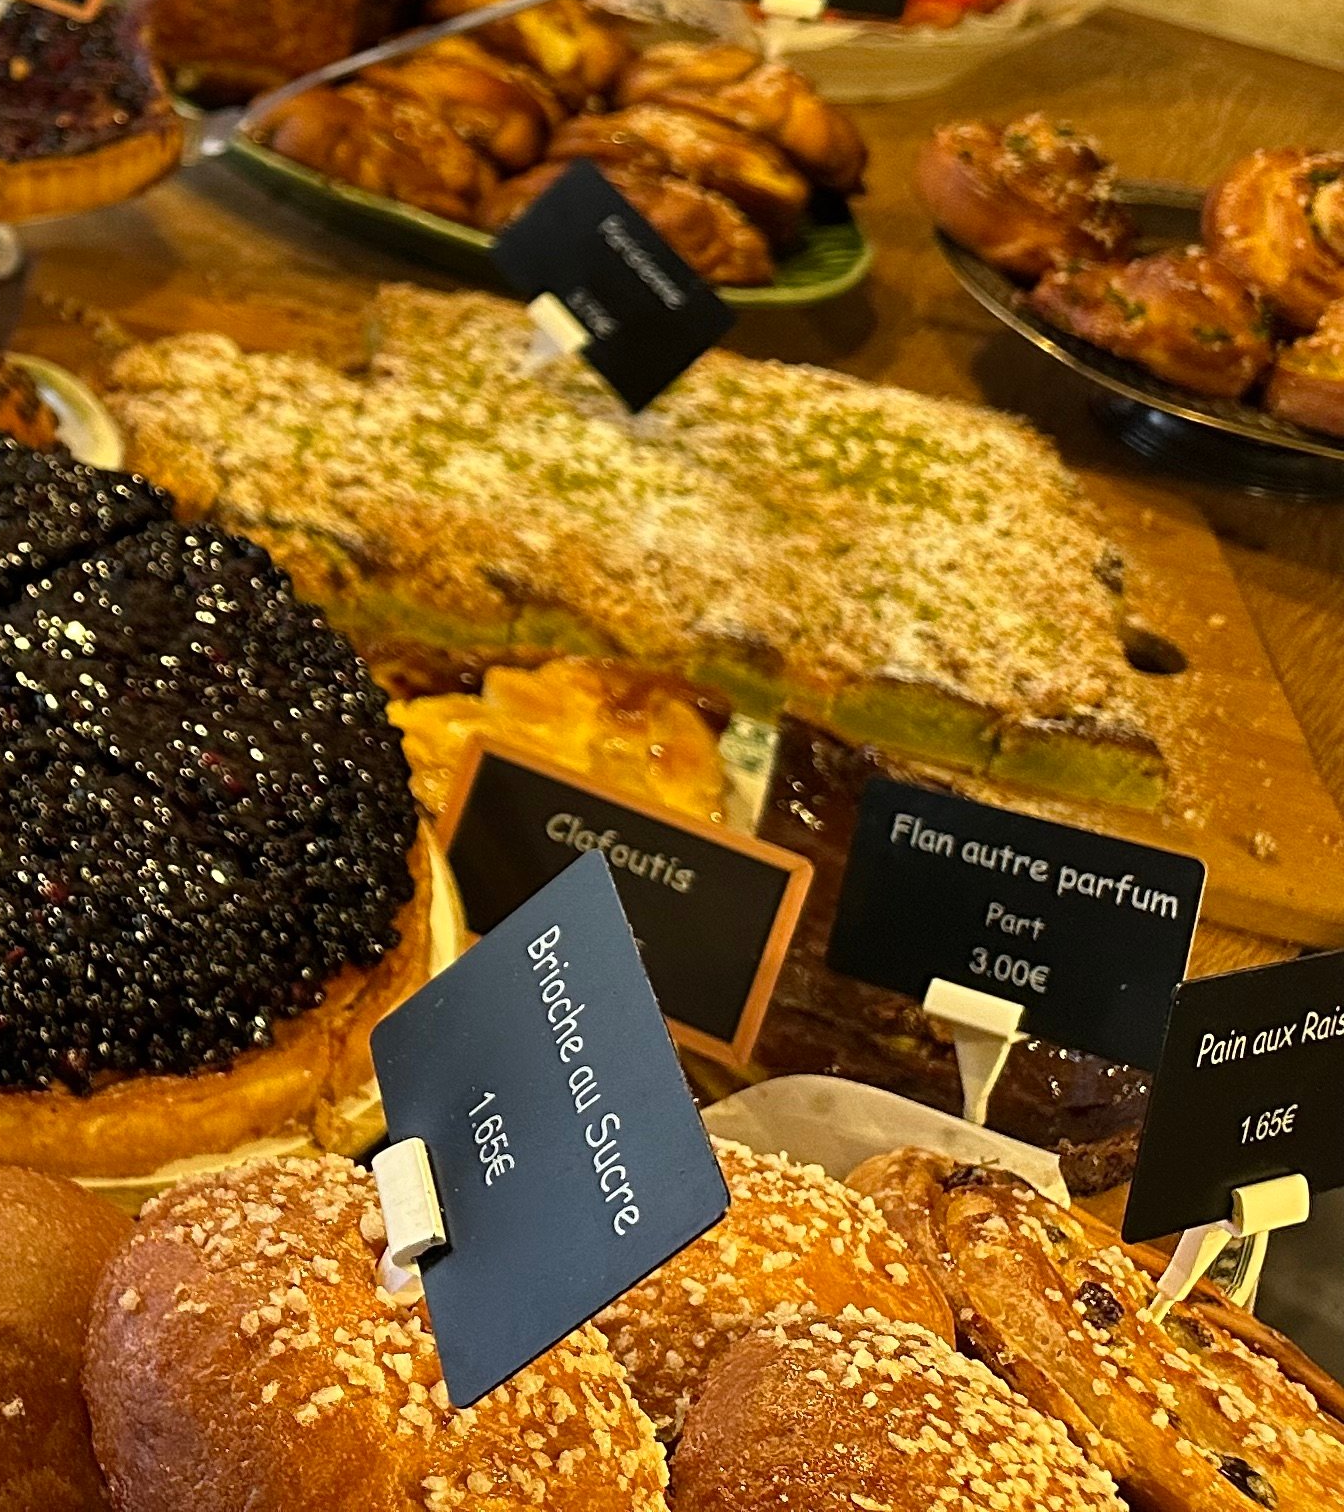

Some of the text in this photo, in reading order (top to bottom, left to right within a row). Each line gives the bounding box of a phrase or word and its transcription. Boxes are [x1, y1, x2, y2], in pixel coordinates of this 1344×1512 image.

[545, 812, 697, 894] Clafoutis
[889, 812, 1180, 920] Flan autre parfum
[984, 900, 1047, 941] Part
[968, 946, 1052, 995] 3.00€
[1195, 1028, 1247, 1068] Pain
[1252, 1022, 1298, 1057] aux
[526, 923, 641, 1237] Brioche au Sucre
[468, 1090, 516, 1188] 1.65€
[1240, 1102, 1300, 1145] 1.65€
